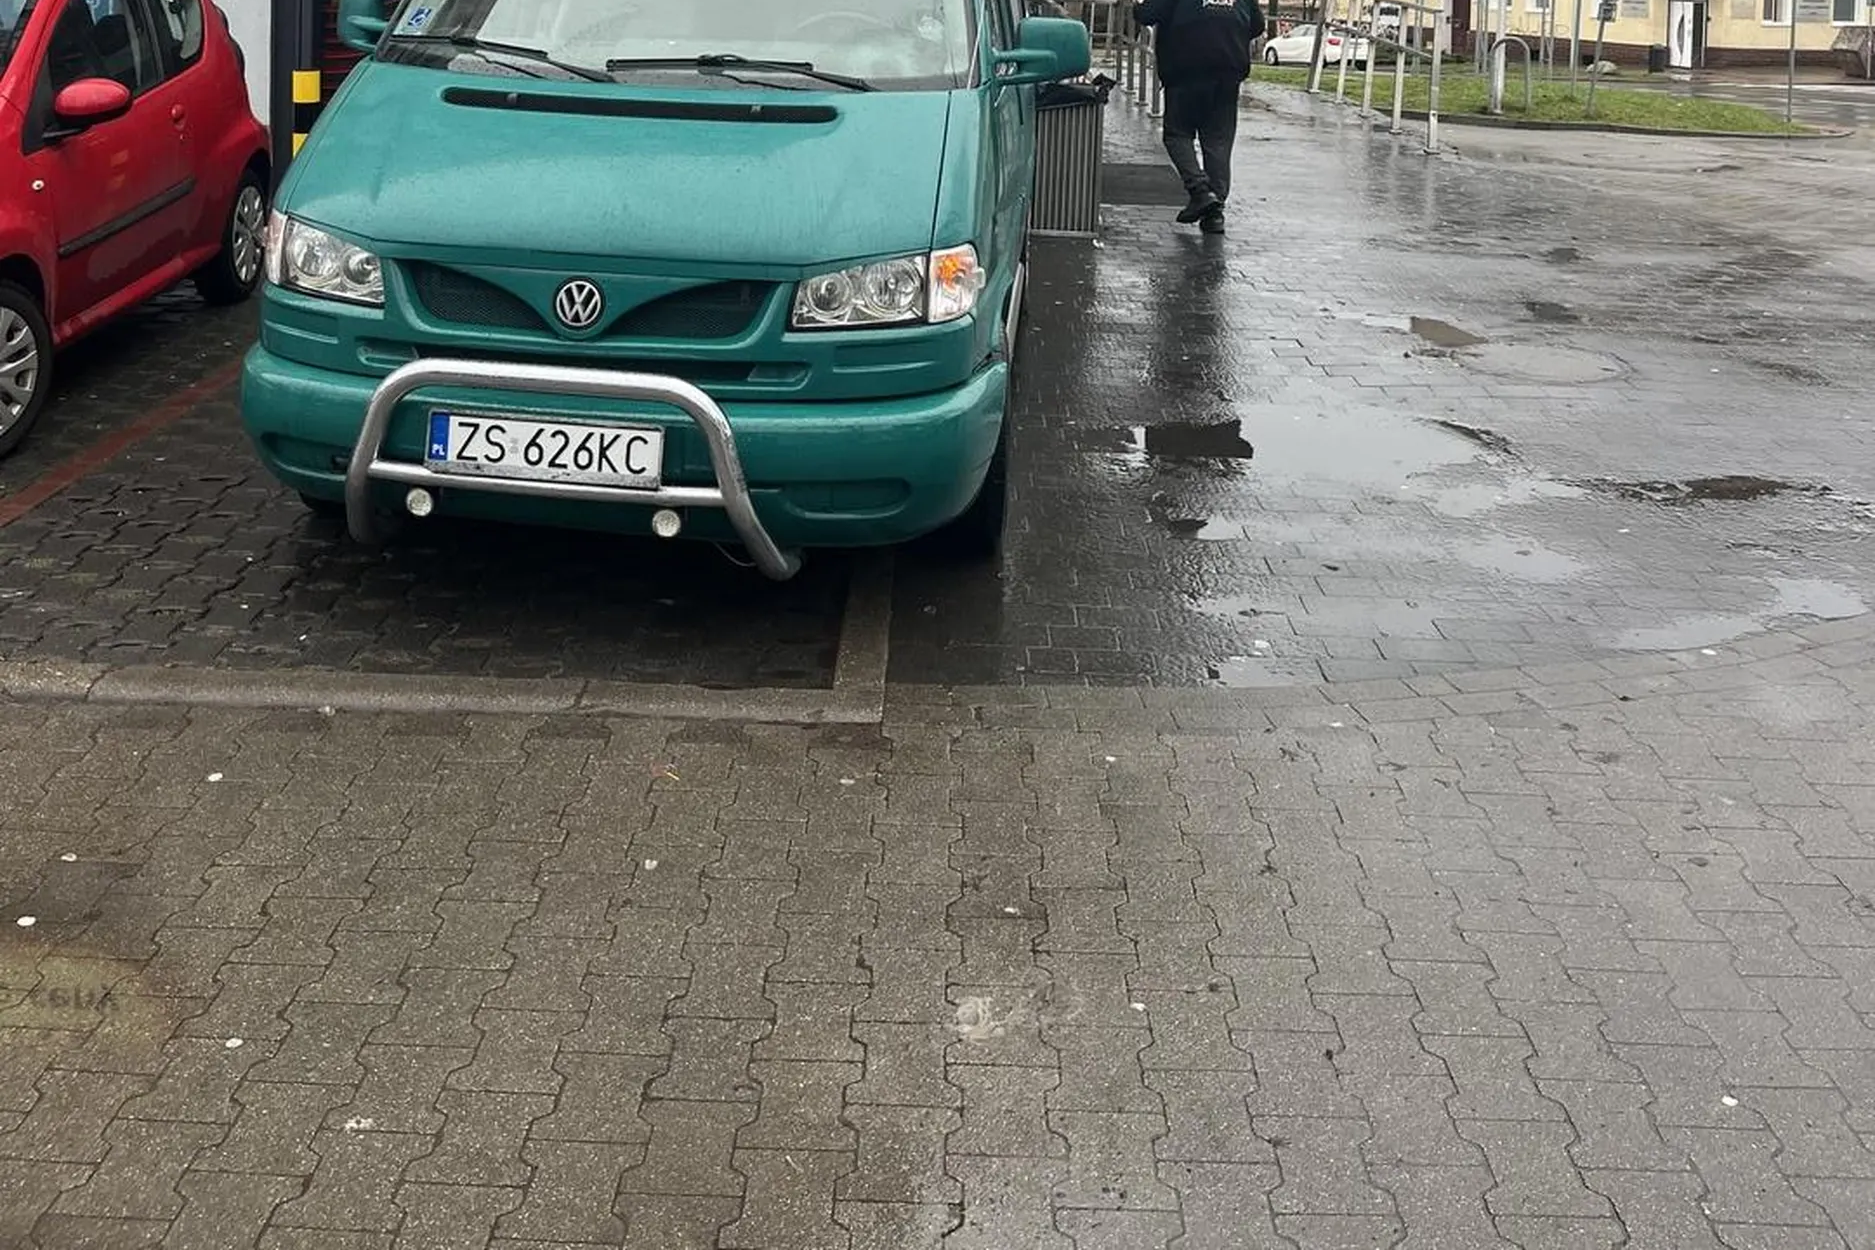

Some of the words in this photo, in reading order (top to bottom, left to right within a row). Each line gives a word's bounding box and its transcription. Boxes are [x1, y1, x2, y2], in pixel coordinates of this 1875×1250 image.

[432, 444, 446, 456] PL
[456, 421, 507, 463] ZS
[523, 427, 649, 475] 626KC
